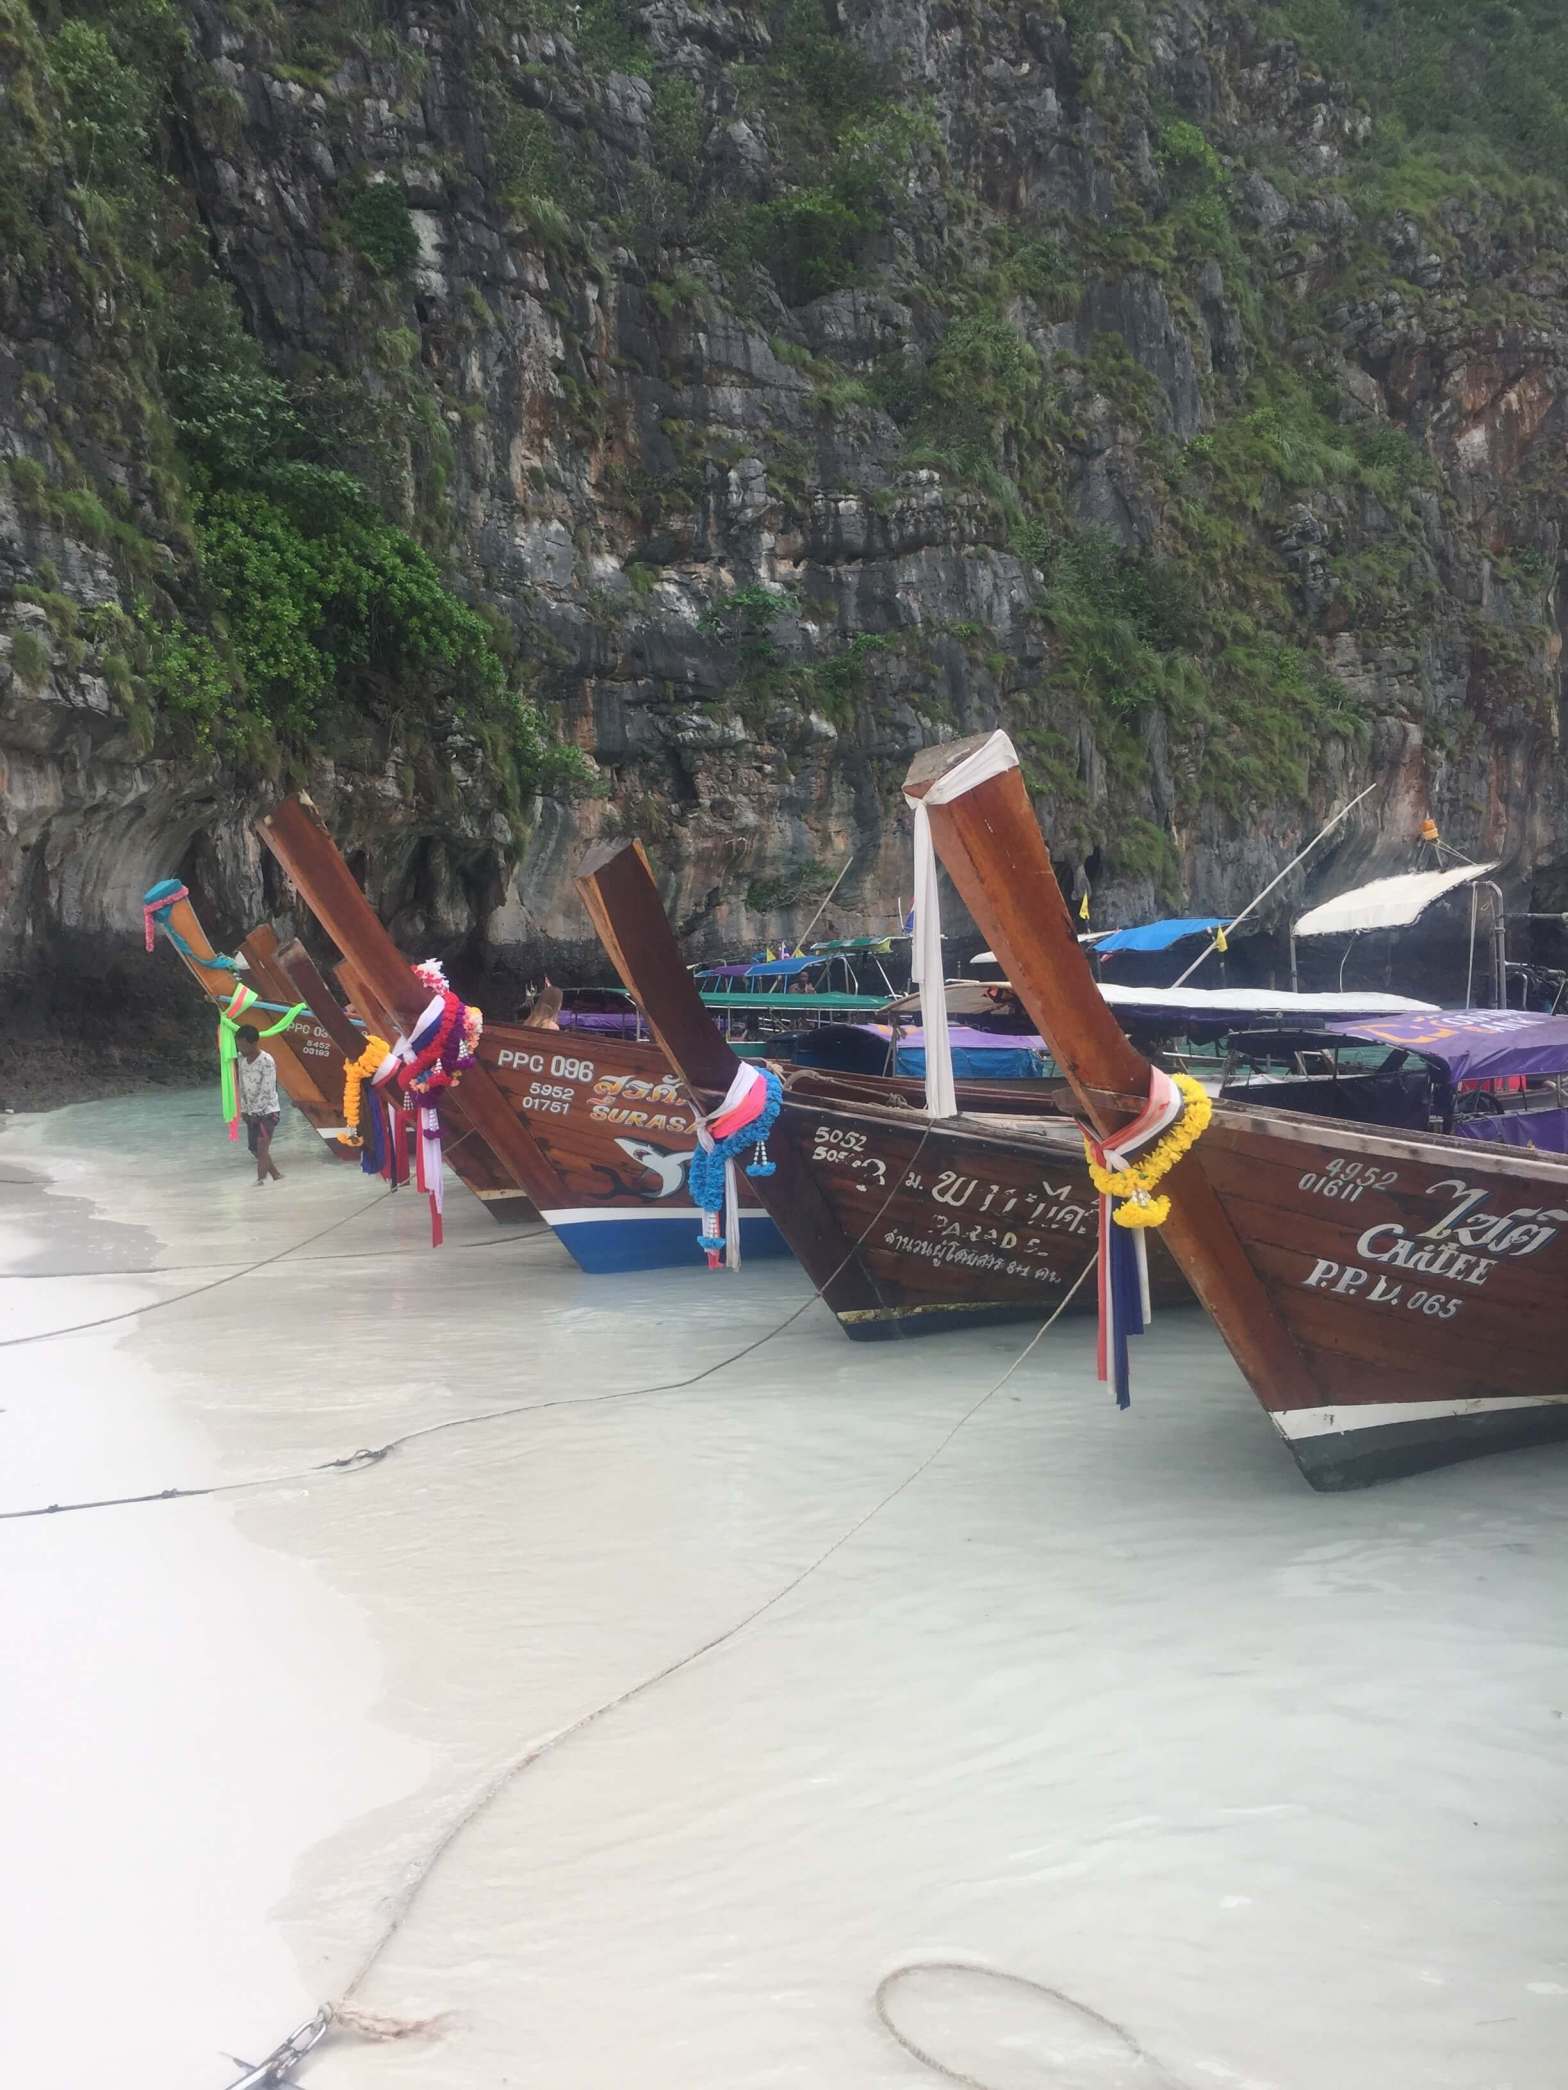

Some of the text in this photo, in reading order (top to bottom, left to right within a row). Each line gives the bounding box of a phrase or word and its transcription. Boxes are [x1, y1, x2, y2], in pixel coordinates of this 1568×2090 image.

[497, 1049, 595, 1082] PPC 096
[522, 1096, 571, 1115] 01751
[529, 1082, 575, 1101] 5952
[814, 1126, 868, 1152] 5052
[1298, 1173, 1364, 1202] 01611
[1325, 1158, 1399, 1190] 4952
[1407, 1290, 1465, 1320] 065
